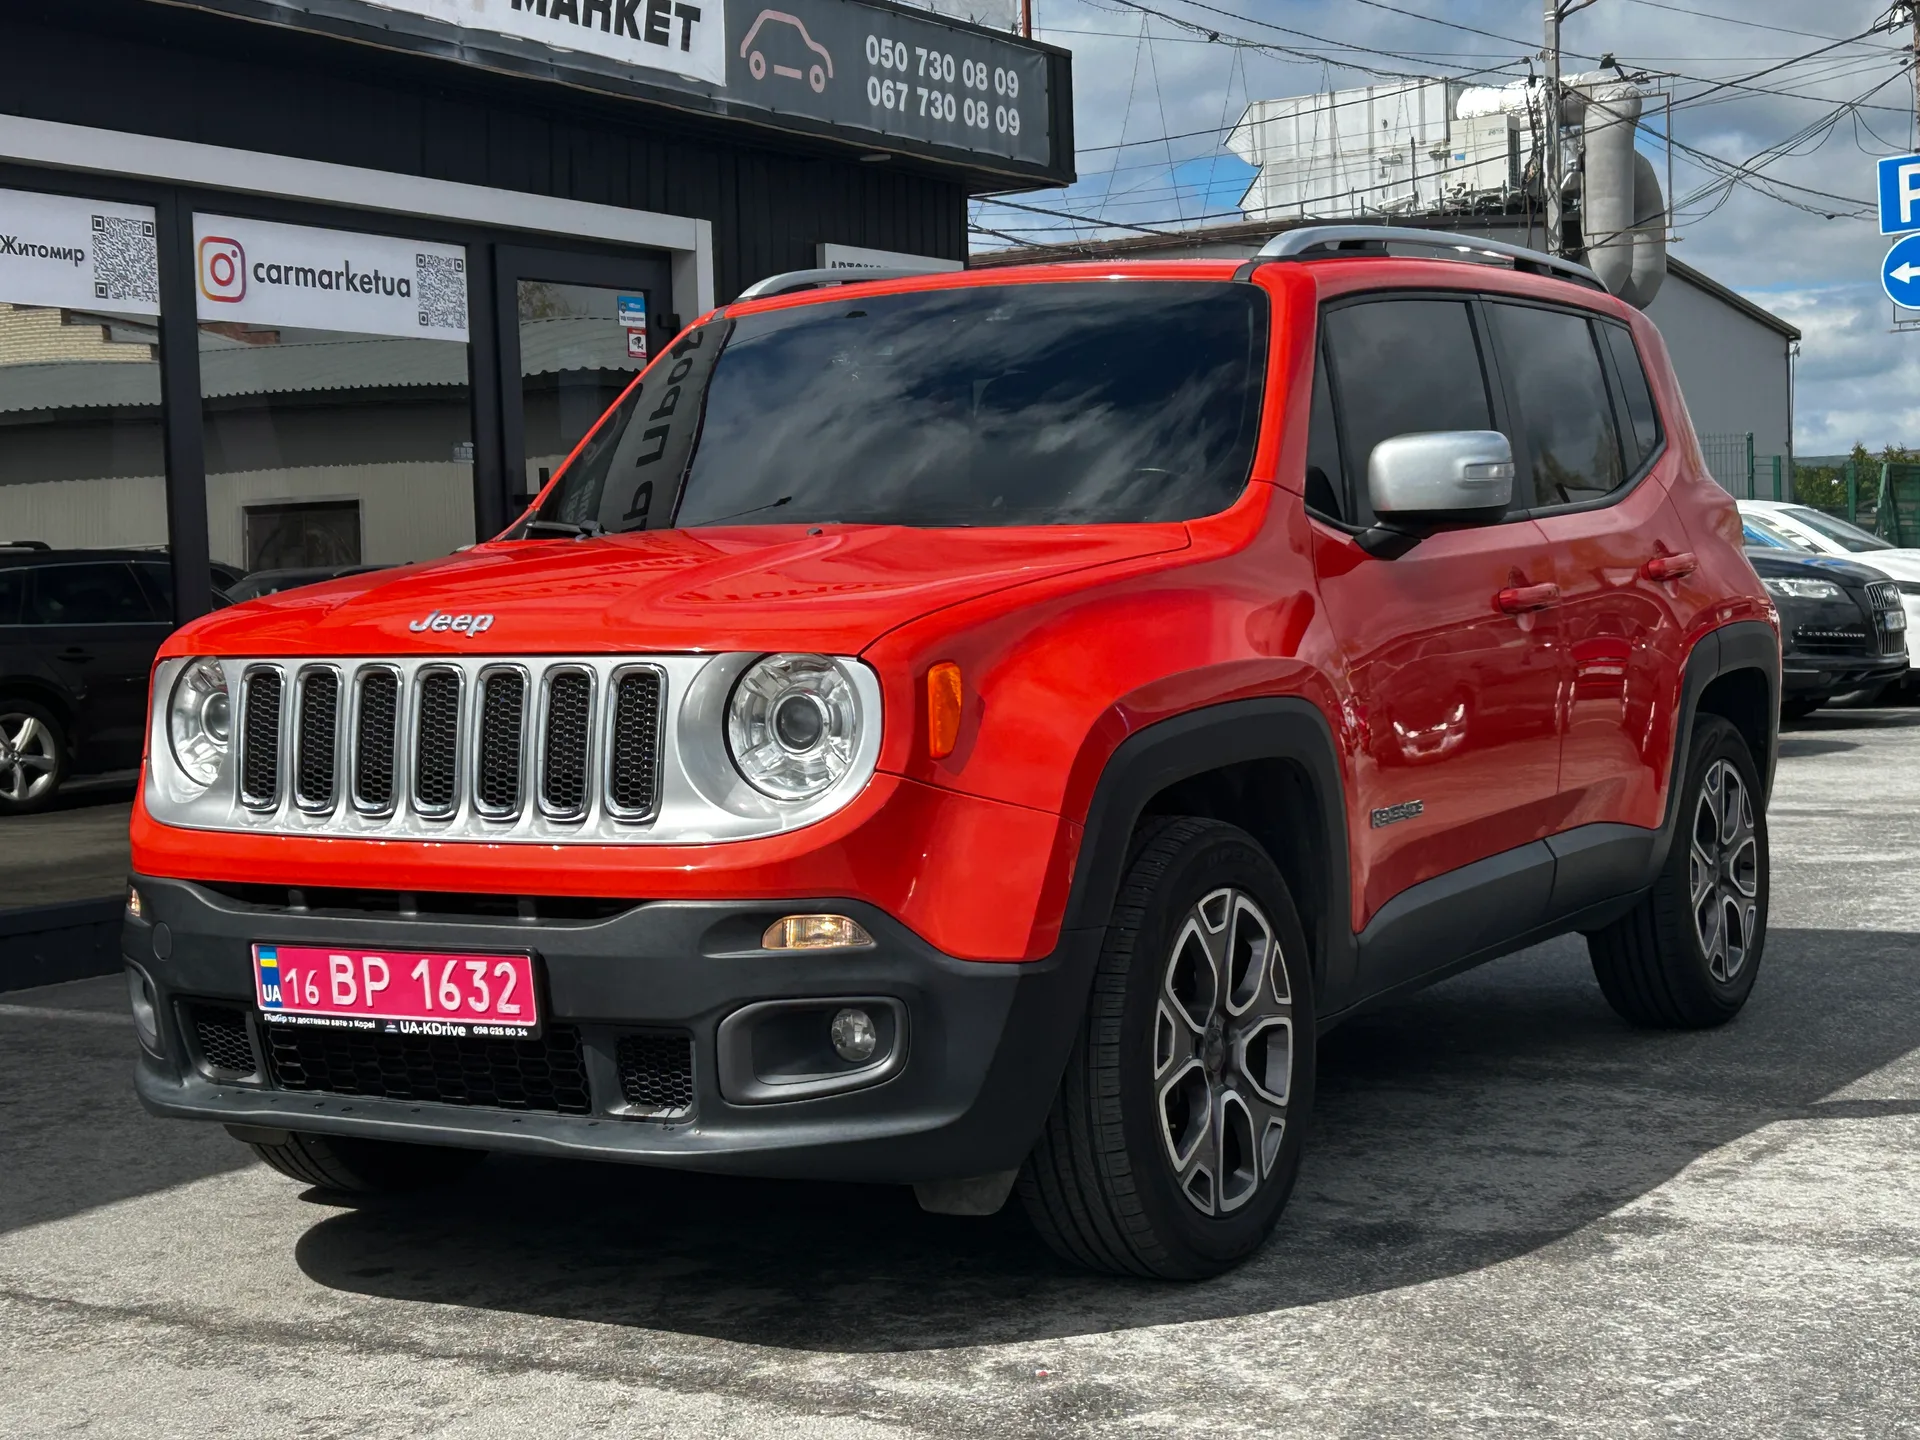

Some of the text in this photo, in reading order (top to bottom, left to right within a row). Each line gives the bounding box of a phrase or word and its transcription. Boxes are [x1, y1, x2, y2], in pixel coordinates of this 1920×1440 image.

[510, 0, 701, 52] ARKET
[866, 35, 1019, 98] 050 730 08 09
[867, 76, 1020, 136] 067 730 08 09
[0, 235, 85, 267] Житомир
[253, 260, 411, 298] carmarketua
[409, 609, 494, 637] Jeep
[262, 984, 282, 1003] UA
[285, 955, 520, 1014] 16 BP 1632
